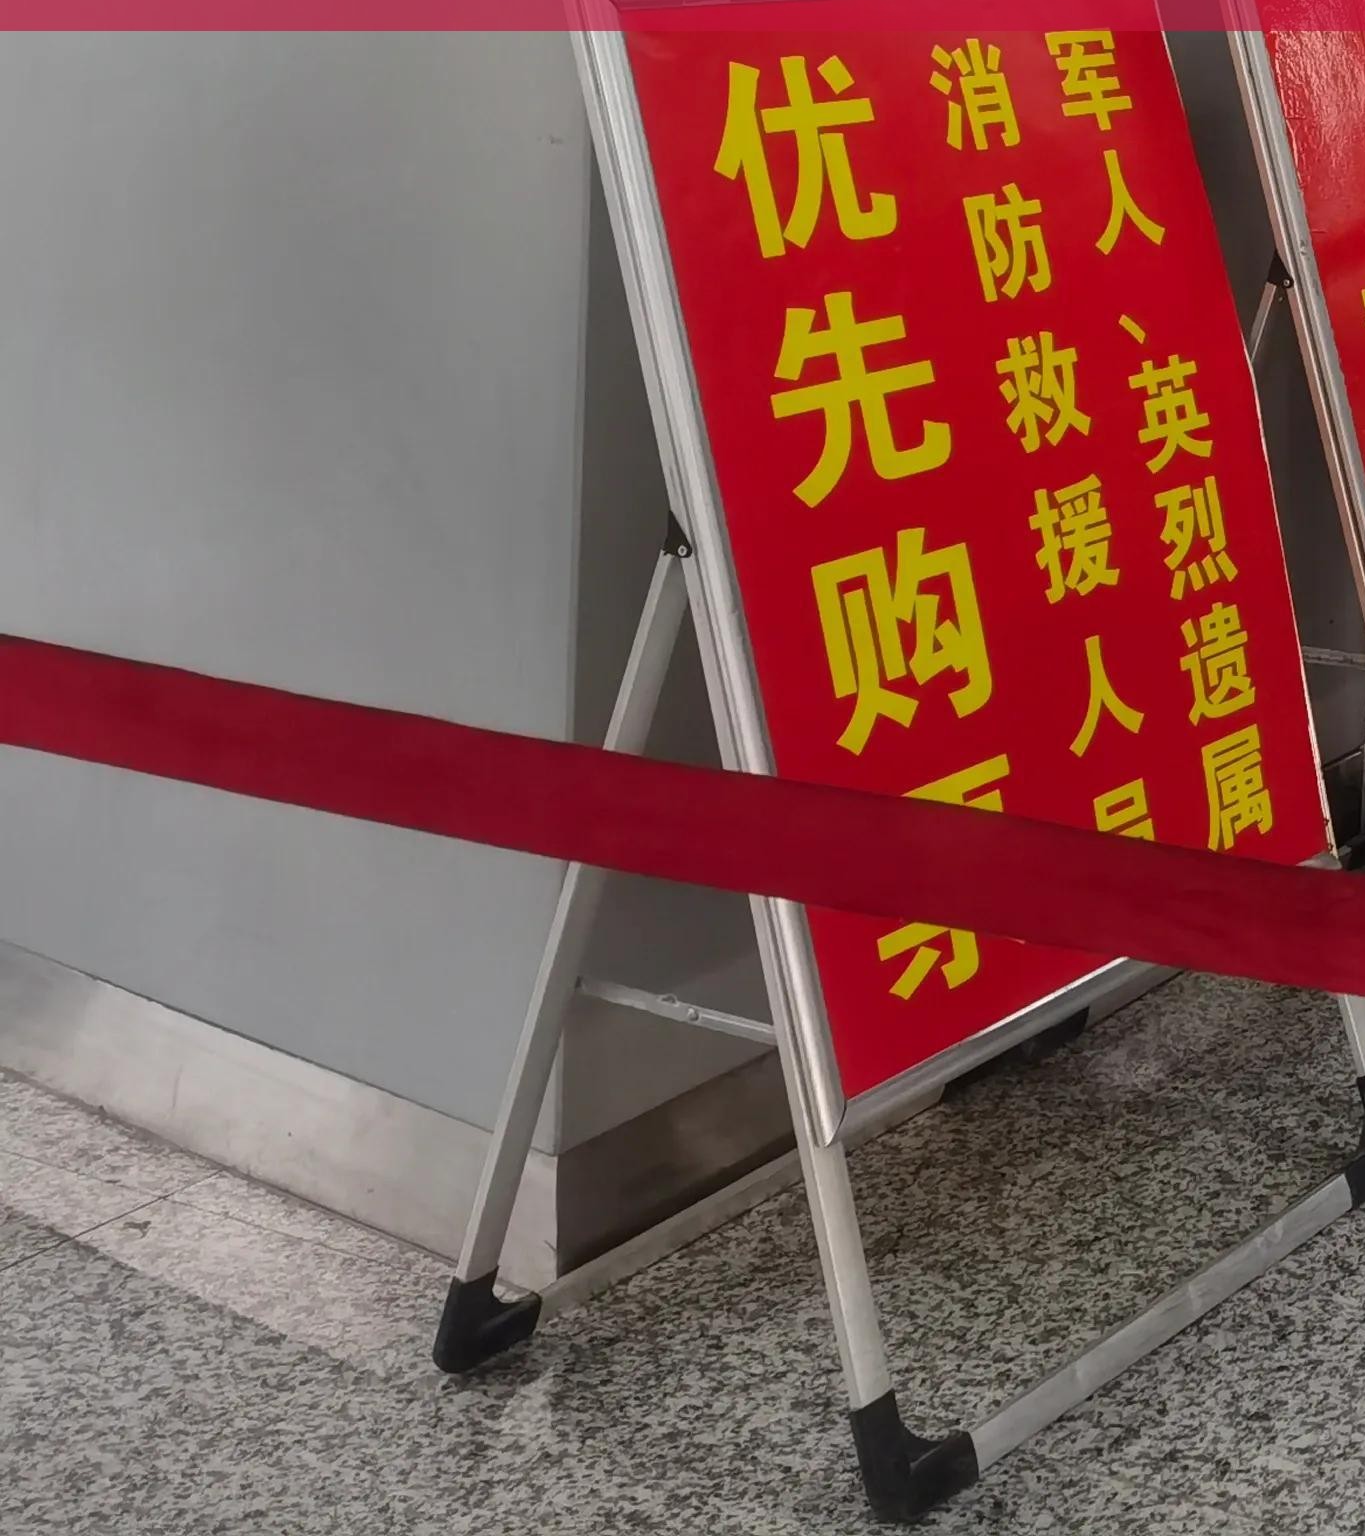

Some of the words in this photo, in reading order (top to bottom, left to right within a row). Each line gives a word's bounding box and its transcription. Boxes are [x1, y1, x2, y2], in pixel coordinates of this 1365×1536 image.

[1044, 28, 1275, 852] 军人、英烈遗属
